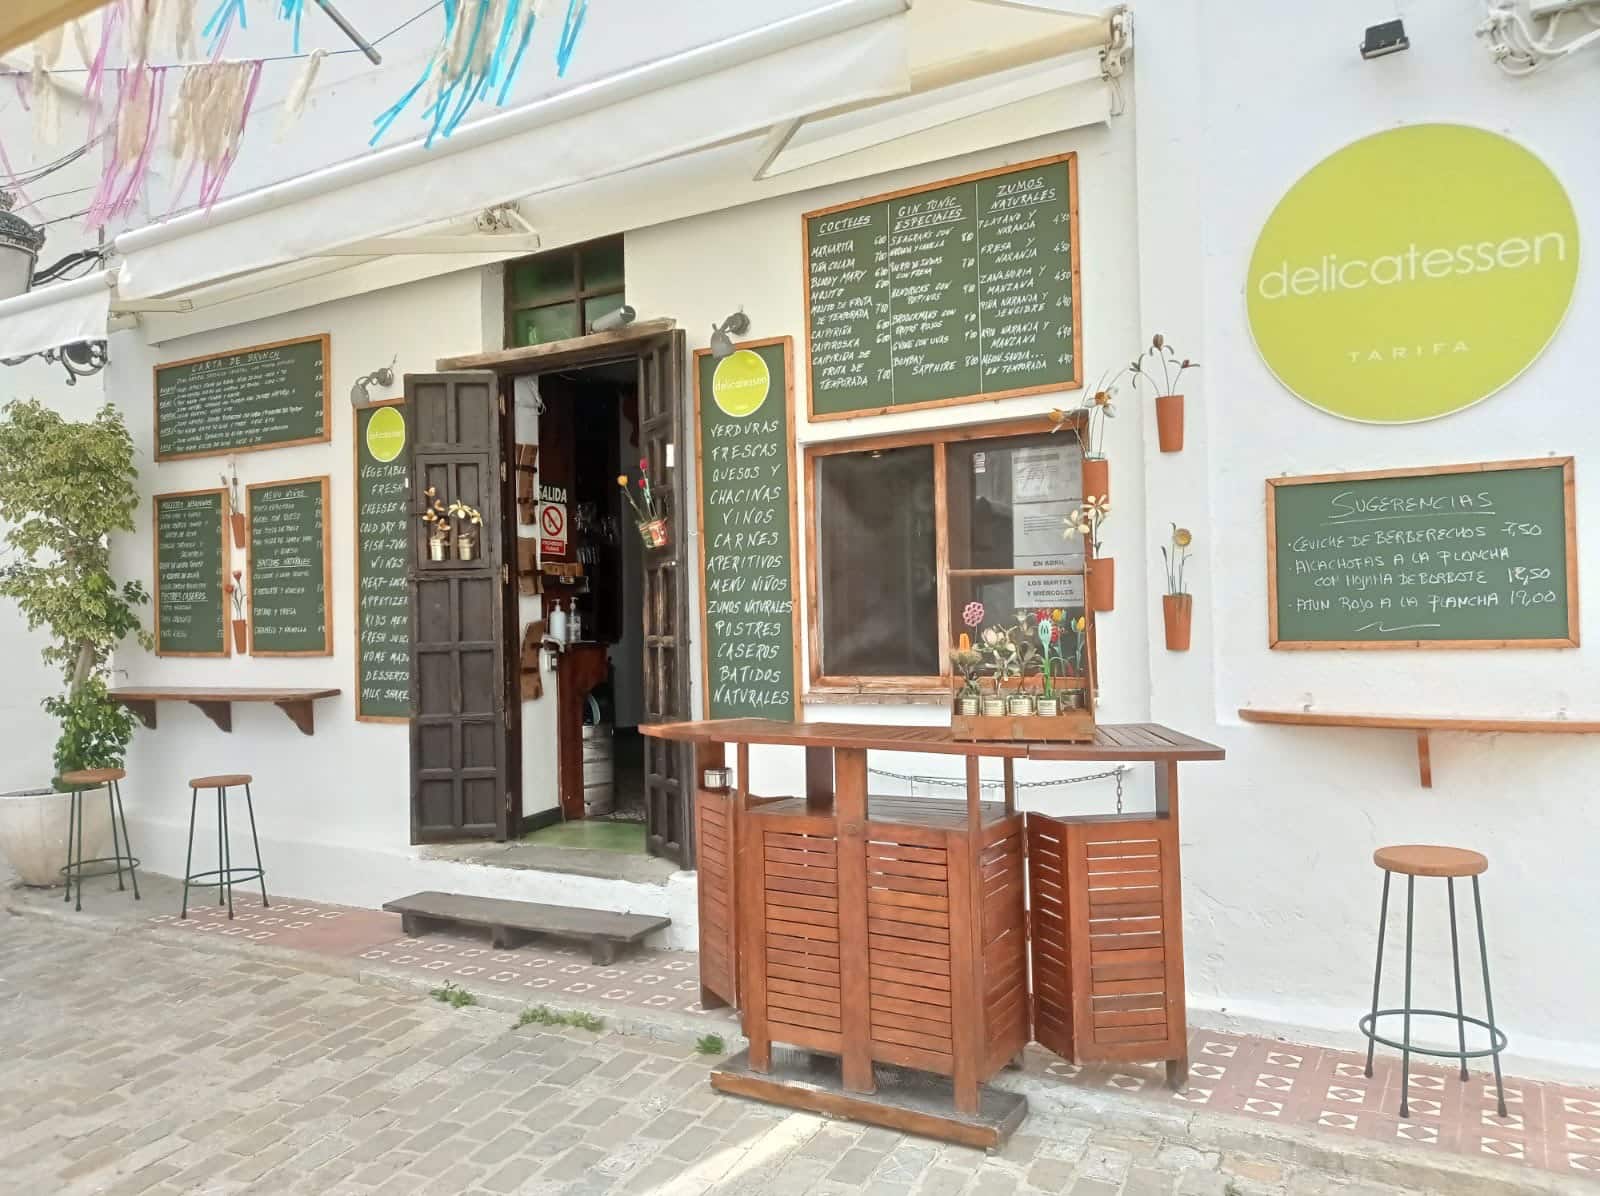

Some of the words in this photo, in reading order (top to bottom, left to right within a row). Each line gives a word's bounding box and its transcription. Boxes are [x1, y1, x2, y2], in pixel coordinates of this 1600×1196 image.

[997, 177, 1043, 196] ZUMOS
[899, 204, 921, 217] GIN
[927, 196, 957, 209] TONIC
[991, 188, 1056, 209] NATURALES
[895, 209, 963, 231] ESPECIALES
[1029, 209, 1037, 220] Y
[820, 216, 871, 233] COCTELES
[997, 220, 1036, 235] NARANJA
[811, 240, 854, 257] MARGARITA
[981, 241, 1012, 255] FRESA
[1025, 238, 1035, 247] Y
[995, 248, 1037, 263] NARANJA
[1039, 265, 1047, 276] Y
[1259, 231, 1566, 299] delicatessen
[839, 270, 868, 284] MARY
[987, 278, 1034, 294] MANZANA
[811, 288, 844, 304] MOJITO
[849, 296, 872, 308] FRUTA
[1001, 293, 1038, 306] NARANJA
[1041, 291, 1048, 300] Y
[829, 309, 869, 321] TEMPORADA
[1001, 321, 1039, 335] NARANJA
[1043, 321, 1050, 330] Y
[929, 336, 949, 344] UVAS
[990, 334, 1036, 349] MANZANA
[1349, 341, 1470, 362] TARIFA
[823, 365, 846, 376] FRUTA
[850, 363, 864, 372] DE
[1002, 360, 1047, 374] TEMPORADA
[820, 376, 868, 390] TEMPORADA
[710, 420, 779, 438] VERDURAS
[711, 443, 777, 462] FRESCAS
[712, 466, 760, 482] QUESOS
[771, 463, 781, 477] Y
[371, 484, 404, 496] FRESH
[710, 485, 781, 505] CHACINAS
[361, 502, 397, 515] CHEESES
[1328, 492, 1493, 518] SUGERENCIAS
[722, 508, 774, 525] VINOS
[380, 521, 396, 535] DRY
[714, 531, 779, 550] CARNES
[1293, 536, 1345, 551] CEVICHE
[1347, 534, 1370, 547] DE
[1375, 526, 1486, 544] BERBERECHOS
[370, 556, 404, 569] WINES
[707, 554, 783, 574] APERITIVOS
[1393, 553, 1404, 566] A
[1412, 552, 1430, 564] LA
[1437, 547, 1509, 567] PLANCHA
[710, 577, 746, 595] MENU
[751, 574, 787, 592] NIÑOS
[1399, 573, 1416, 585] DE
[708, 600, 741, 614] ZUMOS
[744, 599, 793, 616] NATURALES
[1297, 597, 1330, 612] ATUN
[1380, 597, 1392, 609] A
[1400, 596, 1418, 608] LA
[1428, 592, 1498, 613] PLANCHA
[366, 614, 386, 628] KIDS
[714, 619, 781, 637] POSTRES
[361, 631, 386, 644] FRESH
[363, 651, 387, 663] HOME
[717, 642, 780, 661] CASEROS
[719, 664, 781, 683] BATIDOS
[362, 688, 381, 700] MILK
[713, 684, 791, 708] NATURALES
